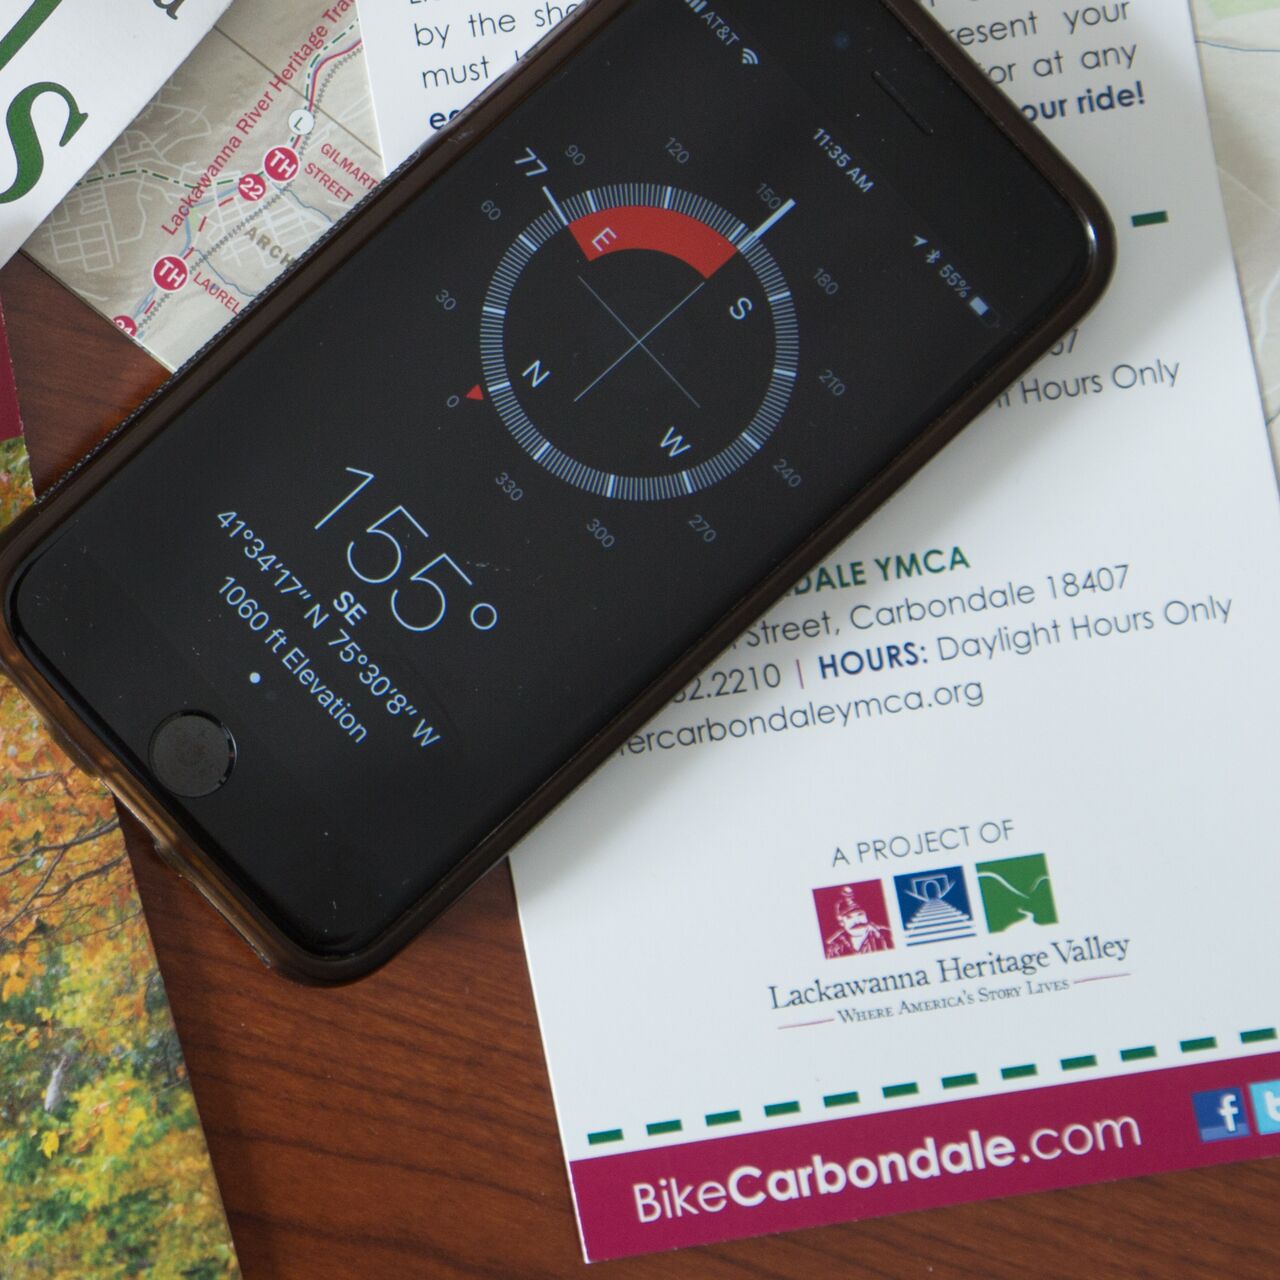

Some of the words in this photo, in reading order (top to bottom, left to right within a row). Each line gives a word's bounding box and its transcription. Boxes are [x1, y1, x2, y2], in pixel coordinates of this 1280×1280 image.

[414, 23, 449, 48] by
[468, 13, 515, 37] the
[703, 12, 740, 45] AT&T
[1063, 2, 1129, 35] your
[422, 56, 489, 88] must
[1033, 51, 1063, 77] at
[1081, 44, 1136, 69] any
[1077, 81, 1144, 114] ride!
[161, 135, 243, 237] Lackawanna
[236, 88, 275, 138] River
[269, 20, 330, 94] Heritage
[270, 150, 297, 178] TH
[515, 146, 549, 179] 77
[564, 144, 587, 167] 90
[663, 136, 690, 164] 120
[812, 127, 851, 169] 11:35
[846, 162, 875, 194] AM
[240, 177, 264, 200] 22
[304, 162, 353, 202] STREET
[756, 181, 781, 211] 150
[480, 199, 502, 222] 60
[592, 226, 617, 252] E
[159, 259, 186, 288] TH
[813, 267, 840, 296] 180
[939, 263, 972, 298] 55%
[435, 288, 457, 311] 30
[729, 296, 754, 321] S
[522, 360, 551, 388] N
[819, 368, 846, 397] 210
[1020, 375, 1103, 405] Hours
[1111, 358, 1180, 389] Only
[659, 426, 692, 458] W
[495, 472, 524, 501] 330
[774, 457, 802, 488] 240
[585, 519, 615, 549] 300
[687, 513, 717, 544] 270
[874, 546, 970, 581] YMCA
[332, 590, 368, 626] SE
[850, 582, 1035, 629] Carbondale
[1047, 564, 1128, 599] 18407
[819, 642, 927, 679] HOURS:
[937, 620, 1060, 661] Daylight
[1070, 611, 1154, 640] Hours
[1163, 595, 1232, 625] Only
[218, 576, 270, 632] 1060
[265, 628, 288, 654] ft
[282, 647, 368, 744] Elevation
[303, 603, 330, 629] N
[412, 718, 441, 748] W
[833, 847, 850, 867] A
[857, 826, 969, 863] PROJECT
[979, 819, 1014, 843] OF
[768, 970, 930, 1009] Lackawanna
[936, 952, 1049, 983] Heritage
[1051, 936, 1130, 964] Valley
[632, 1111, 1141, 1224] BikeCarbondale.com
